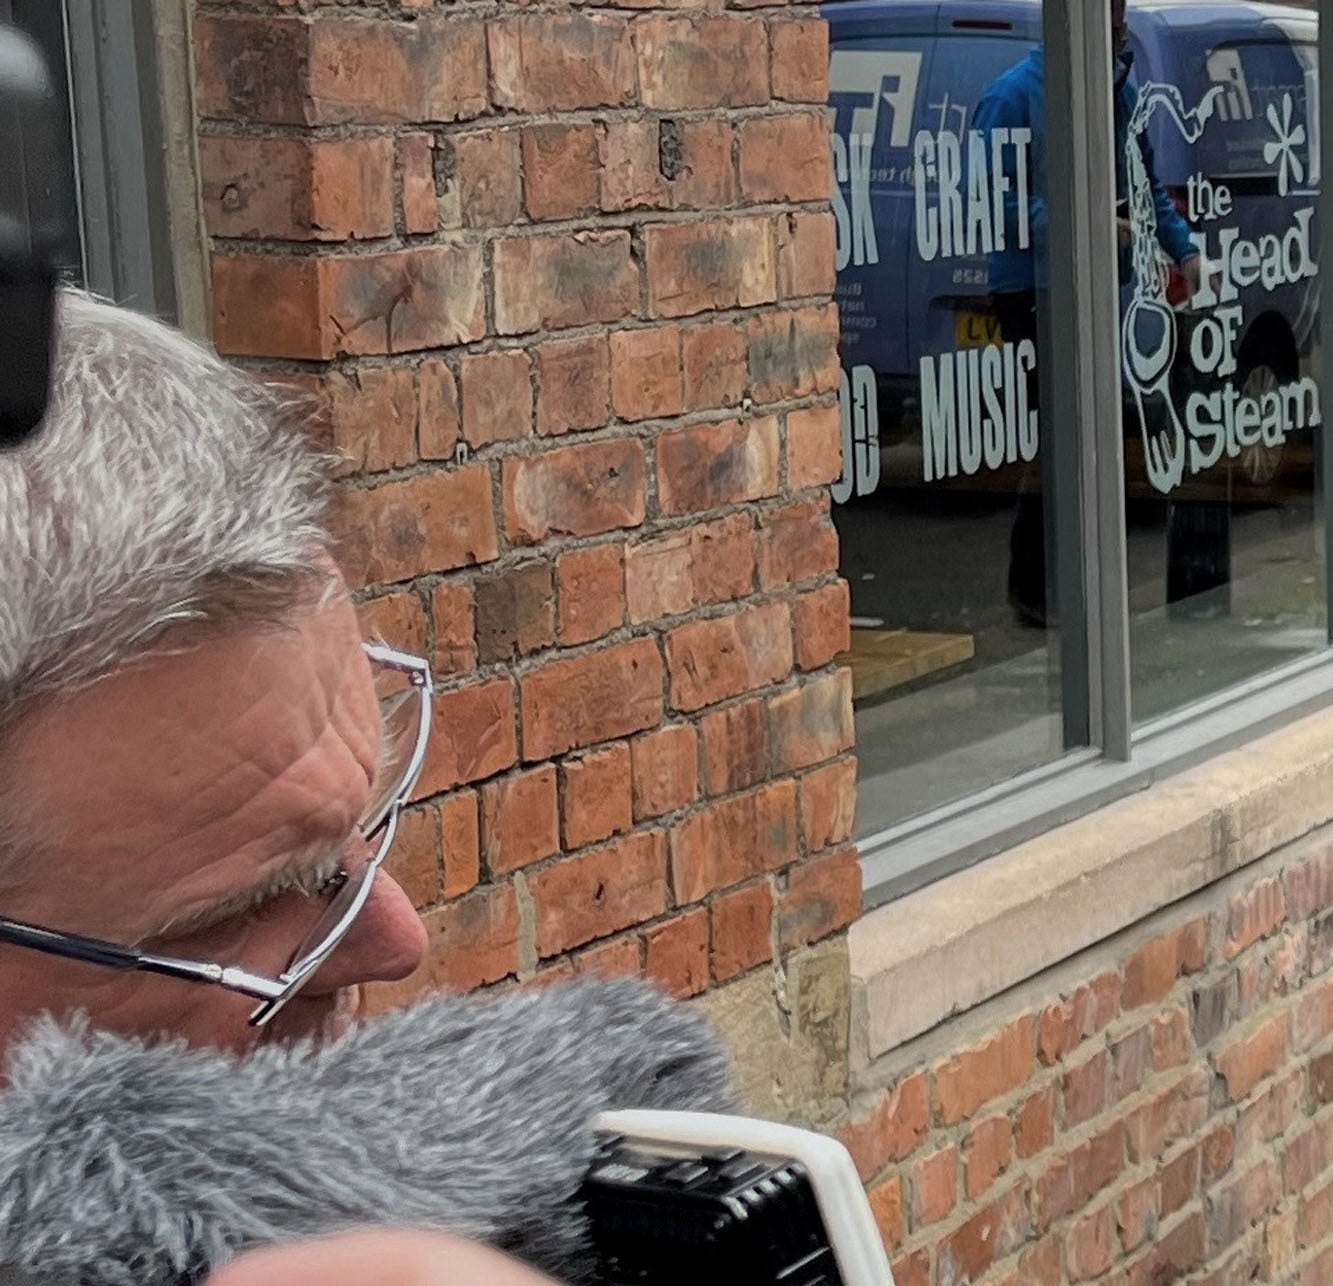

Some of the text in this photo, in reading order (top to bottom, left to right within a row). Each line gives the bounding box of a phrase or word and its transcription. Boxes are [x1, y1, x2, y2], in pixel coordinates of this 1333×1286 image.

[914, 127, 1033, 261] CRAFT
[1187, 171, 1233, 223] the
[1188, 206, 1319, 310] Head
[919, 338, 1039, 482] MUSIC
[1185, 375, 1322, 475] Steam
